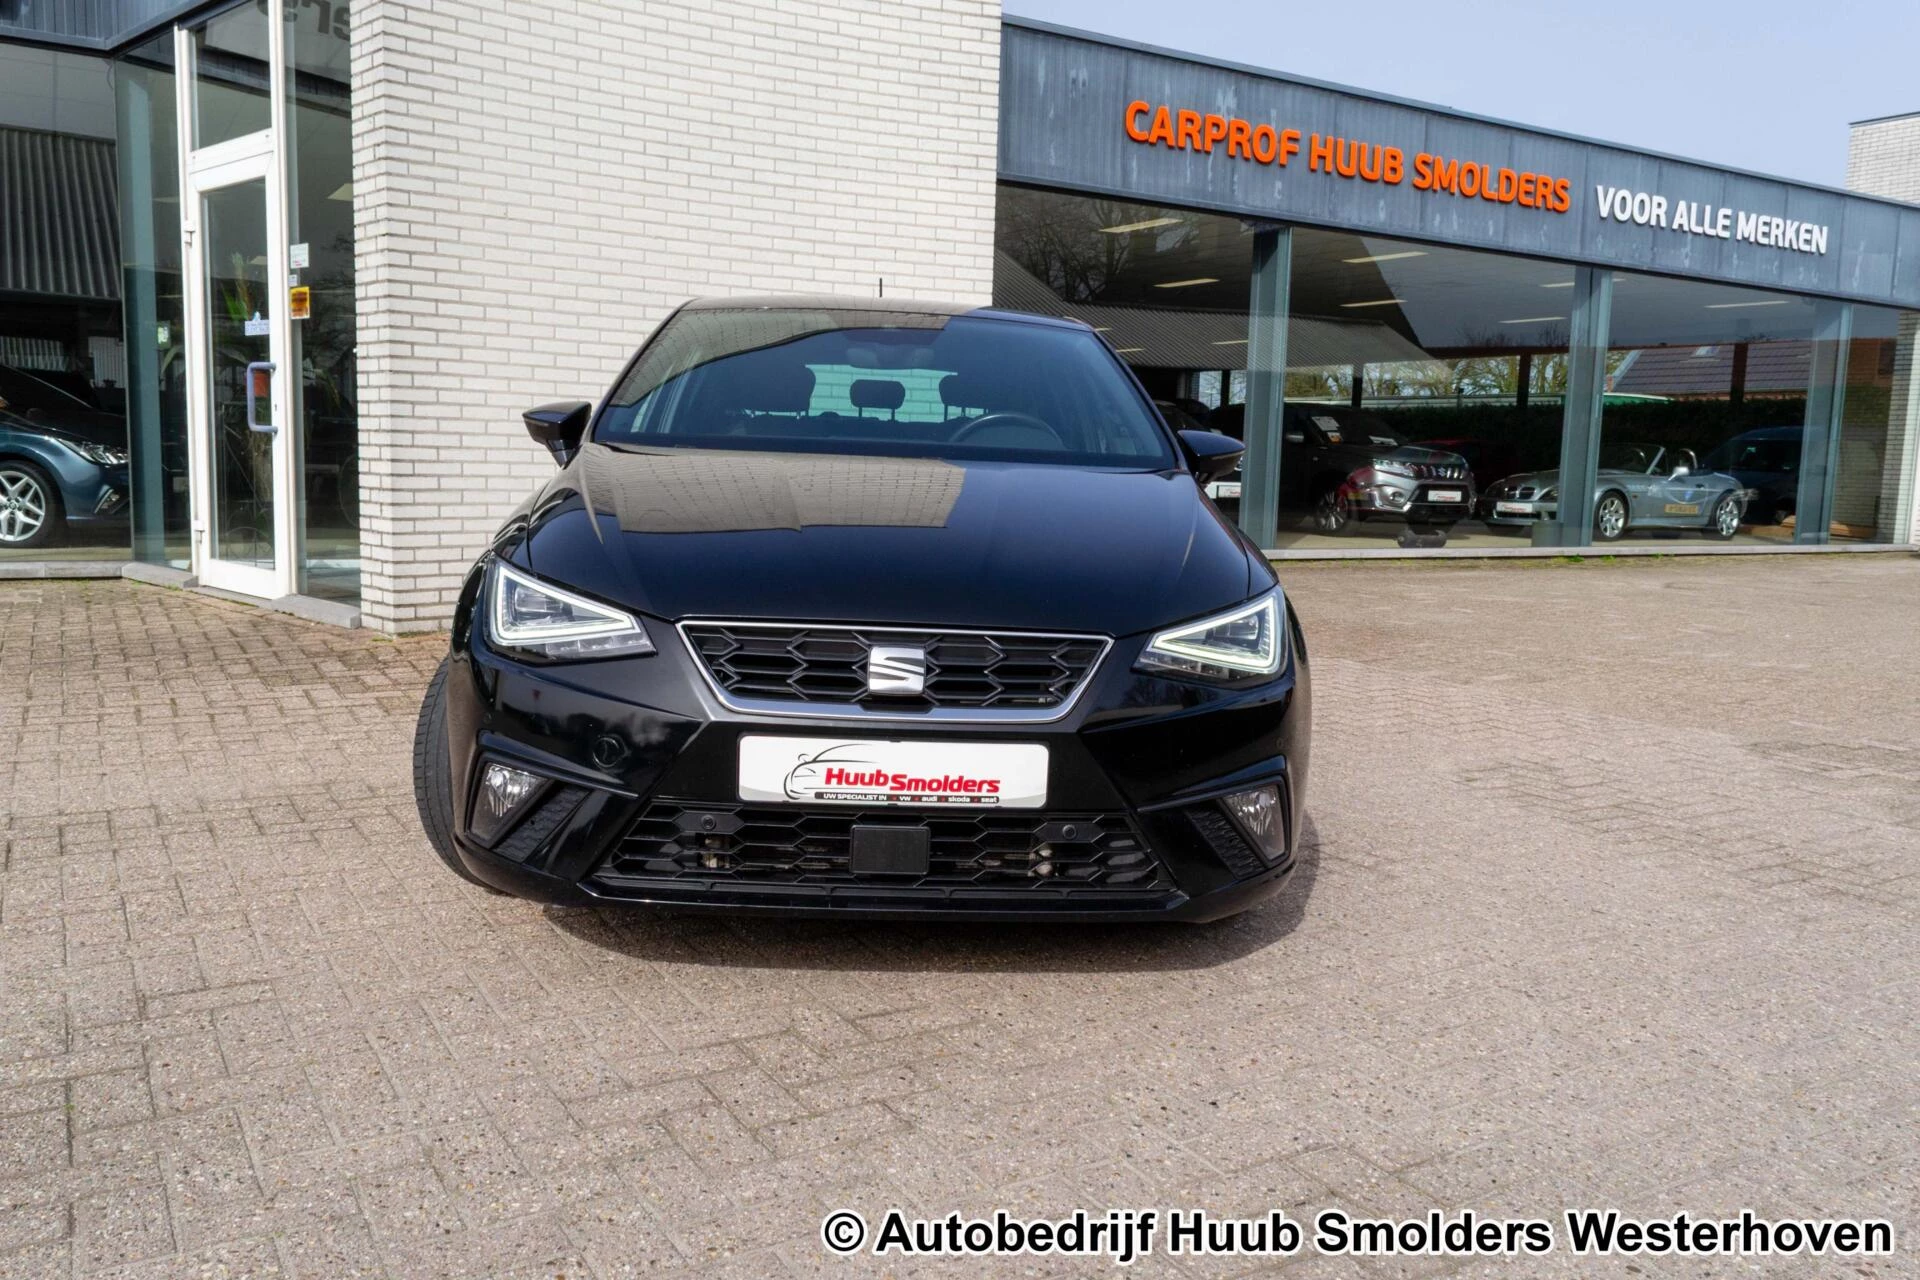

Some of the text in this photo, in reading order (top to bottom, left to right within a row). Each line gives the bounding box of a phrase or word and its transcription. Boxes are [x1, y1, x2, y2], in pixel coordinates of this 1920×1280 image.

[1125, 99, 1572, 214] CARPROF HUUB SMOLDERS
[1596, 184, 1829, 255] VOOR ALLE MERKEN
[837, 793, 878, 801] SPECIALIST
